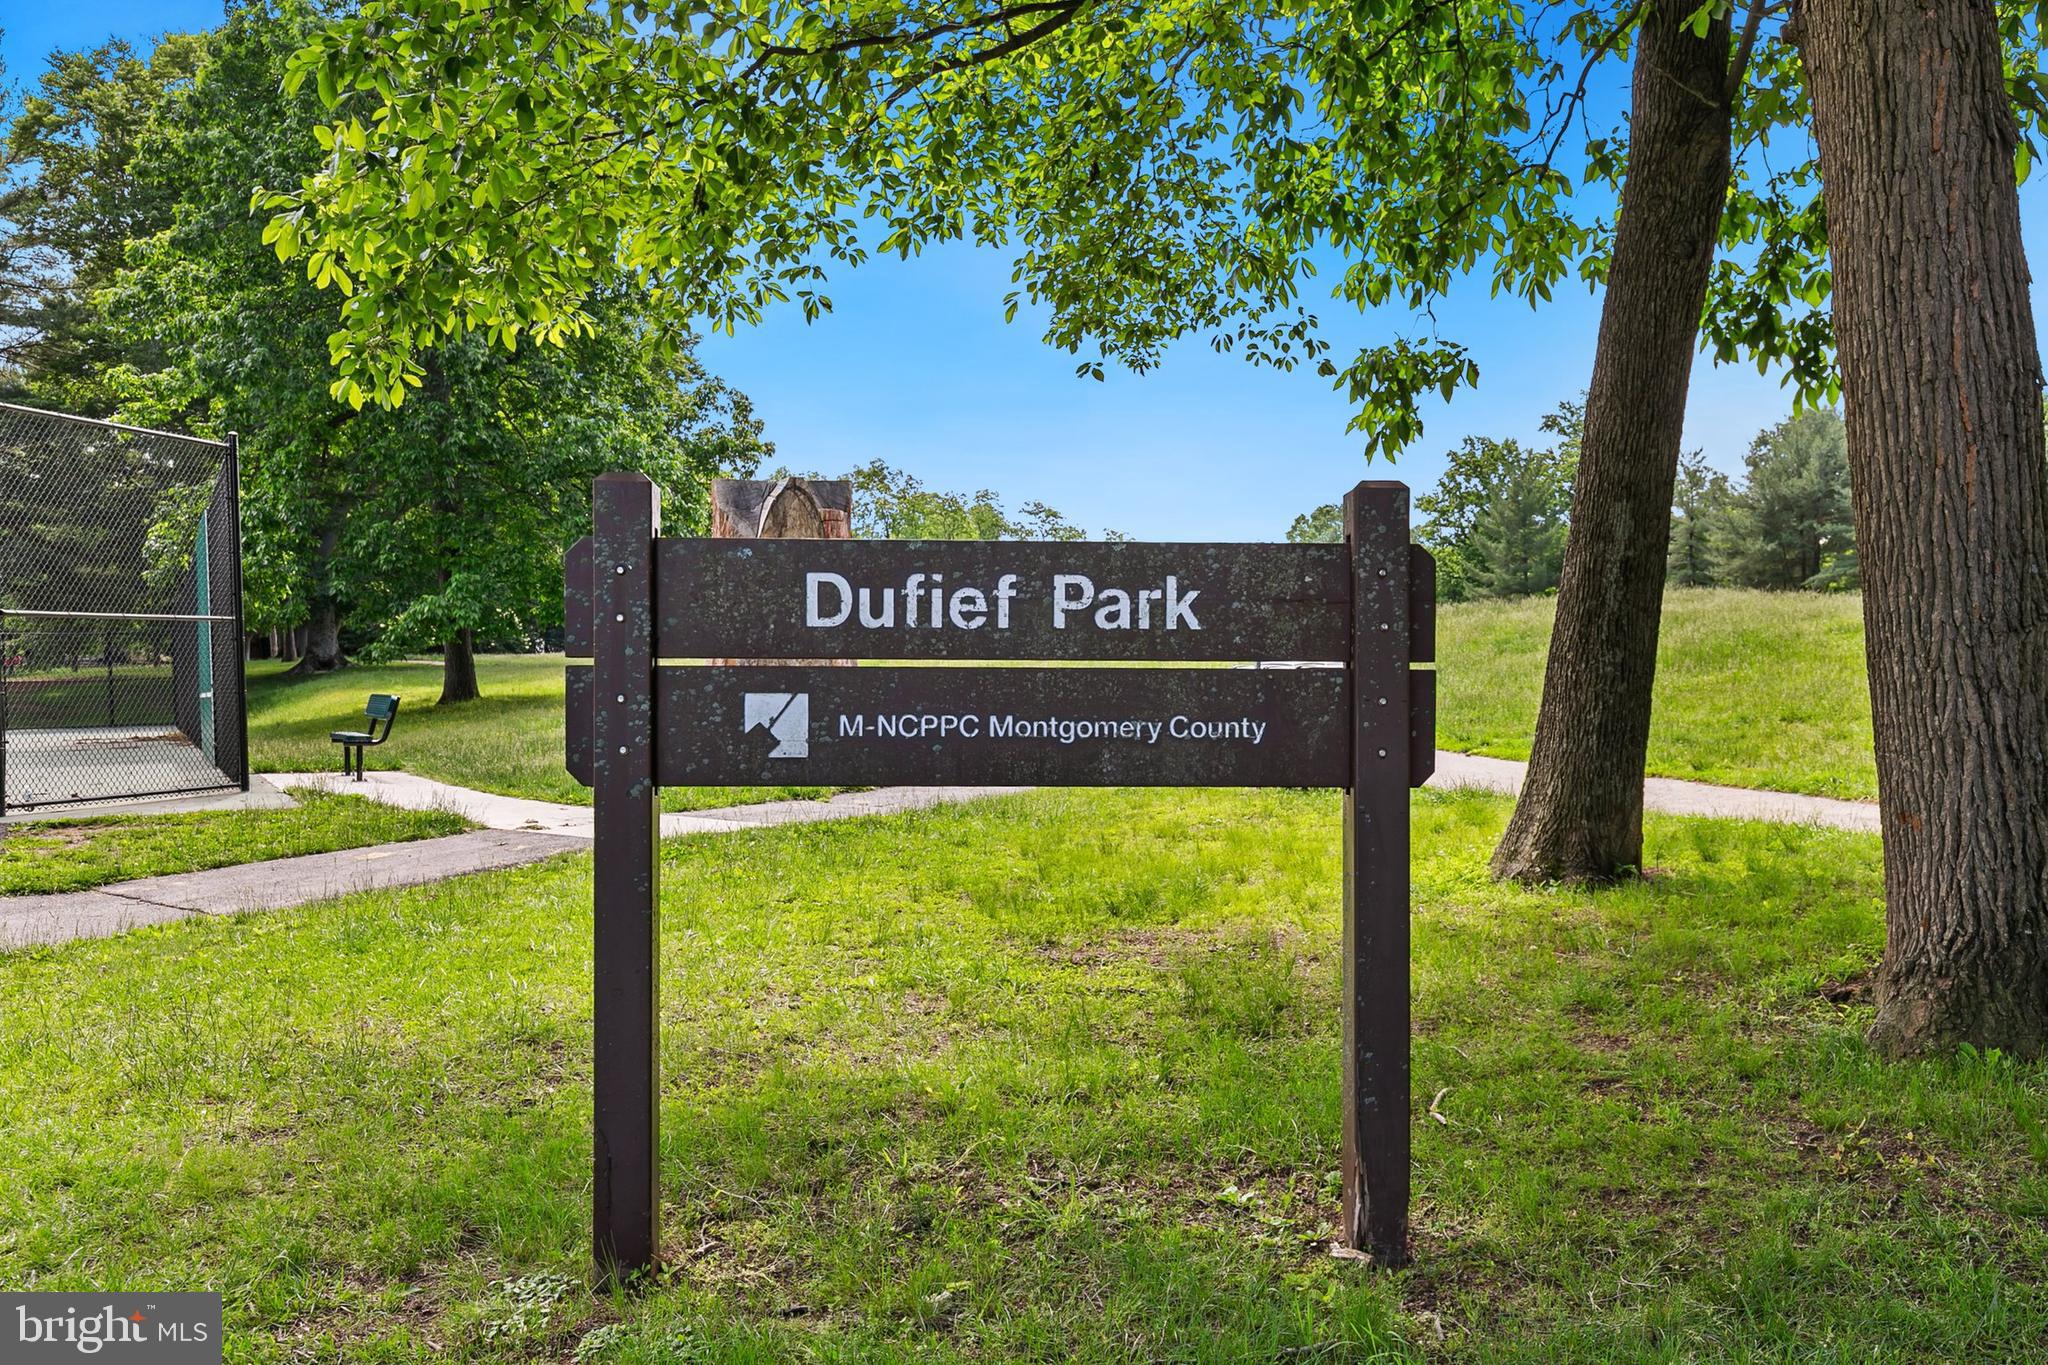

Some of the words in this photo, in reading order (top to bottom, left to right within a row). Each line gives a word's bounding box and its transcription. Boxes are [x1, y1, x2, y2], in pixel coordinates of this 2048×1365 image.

[805, 572, 1018, 630] Dufief
[1053, 574, 1203, 631] Park
[839, 714, 980, 738] M-NCPPC
[989, 715, 1162, 744] Montgomery
[1169, 715, 1267, 744] County
